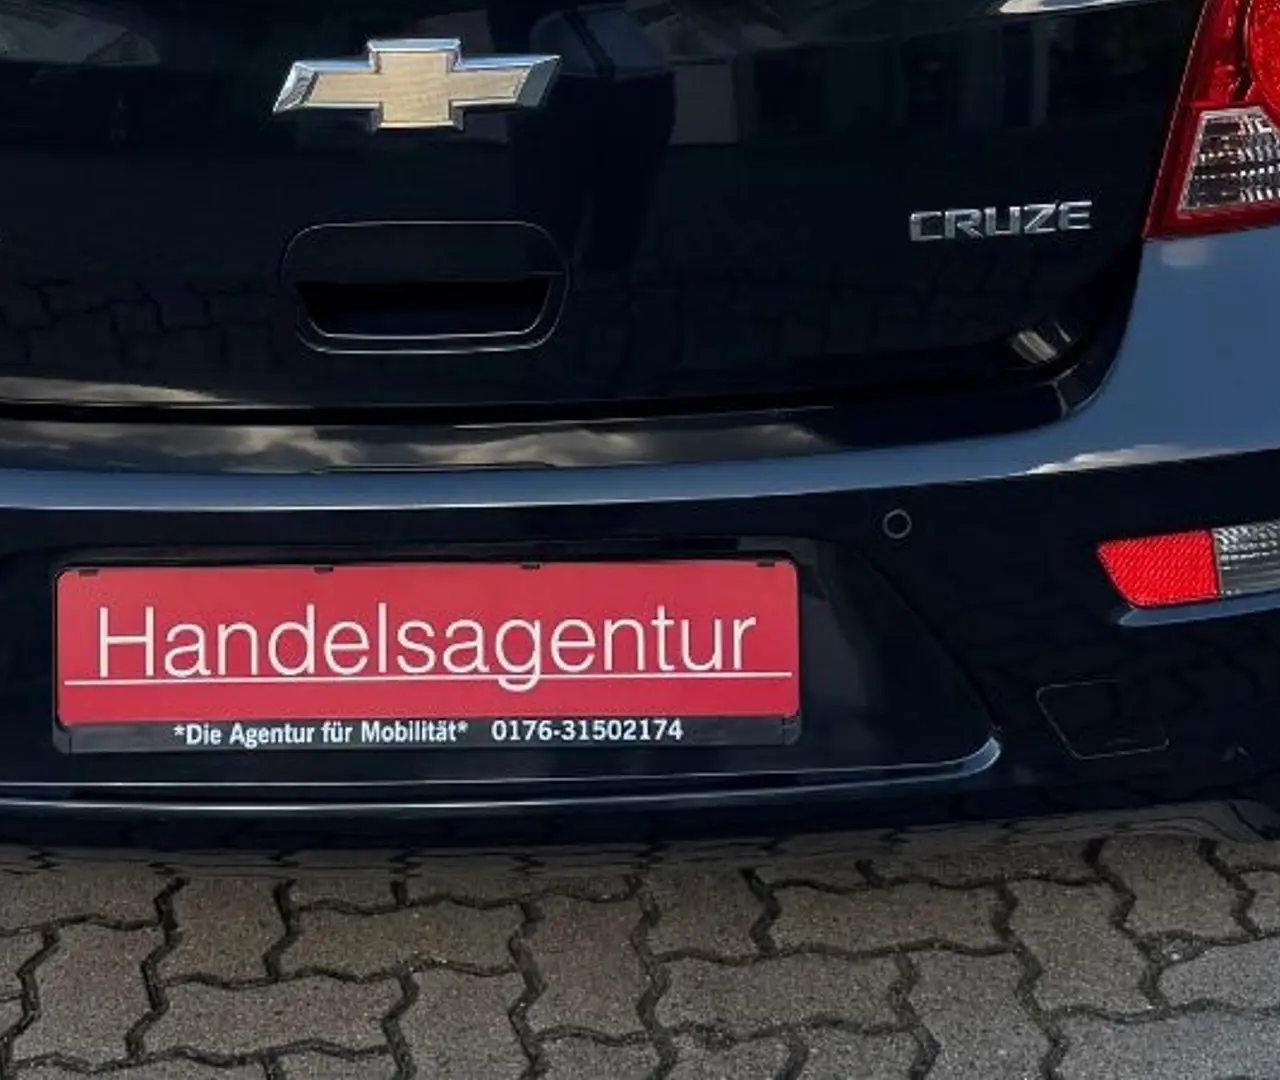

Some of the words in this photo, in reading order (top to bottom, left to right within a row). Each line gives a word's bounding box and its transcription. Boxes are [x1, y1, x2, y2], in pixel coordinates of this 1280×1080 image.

[909, 199, 1093, 242] CRUZE
[99, 601, 757, 693] Handelsagentur
[228, 721, 315, 748] Agentur
[320, 720, 353, 744] für
[490, 718, 684, 742] 0176-31502174
